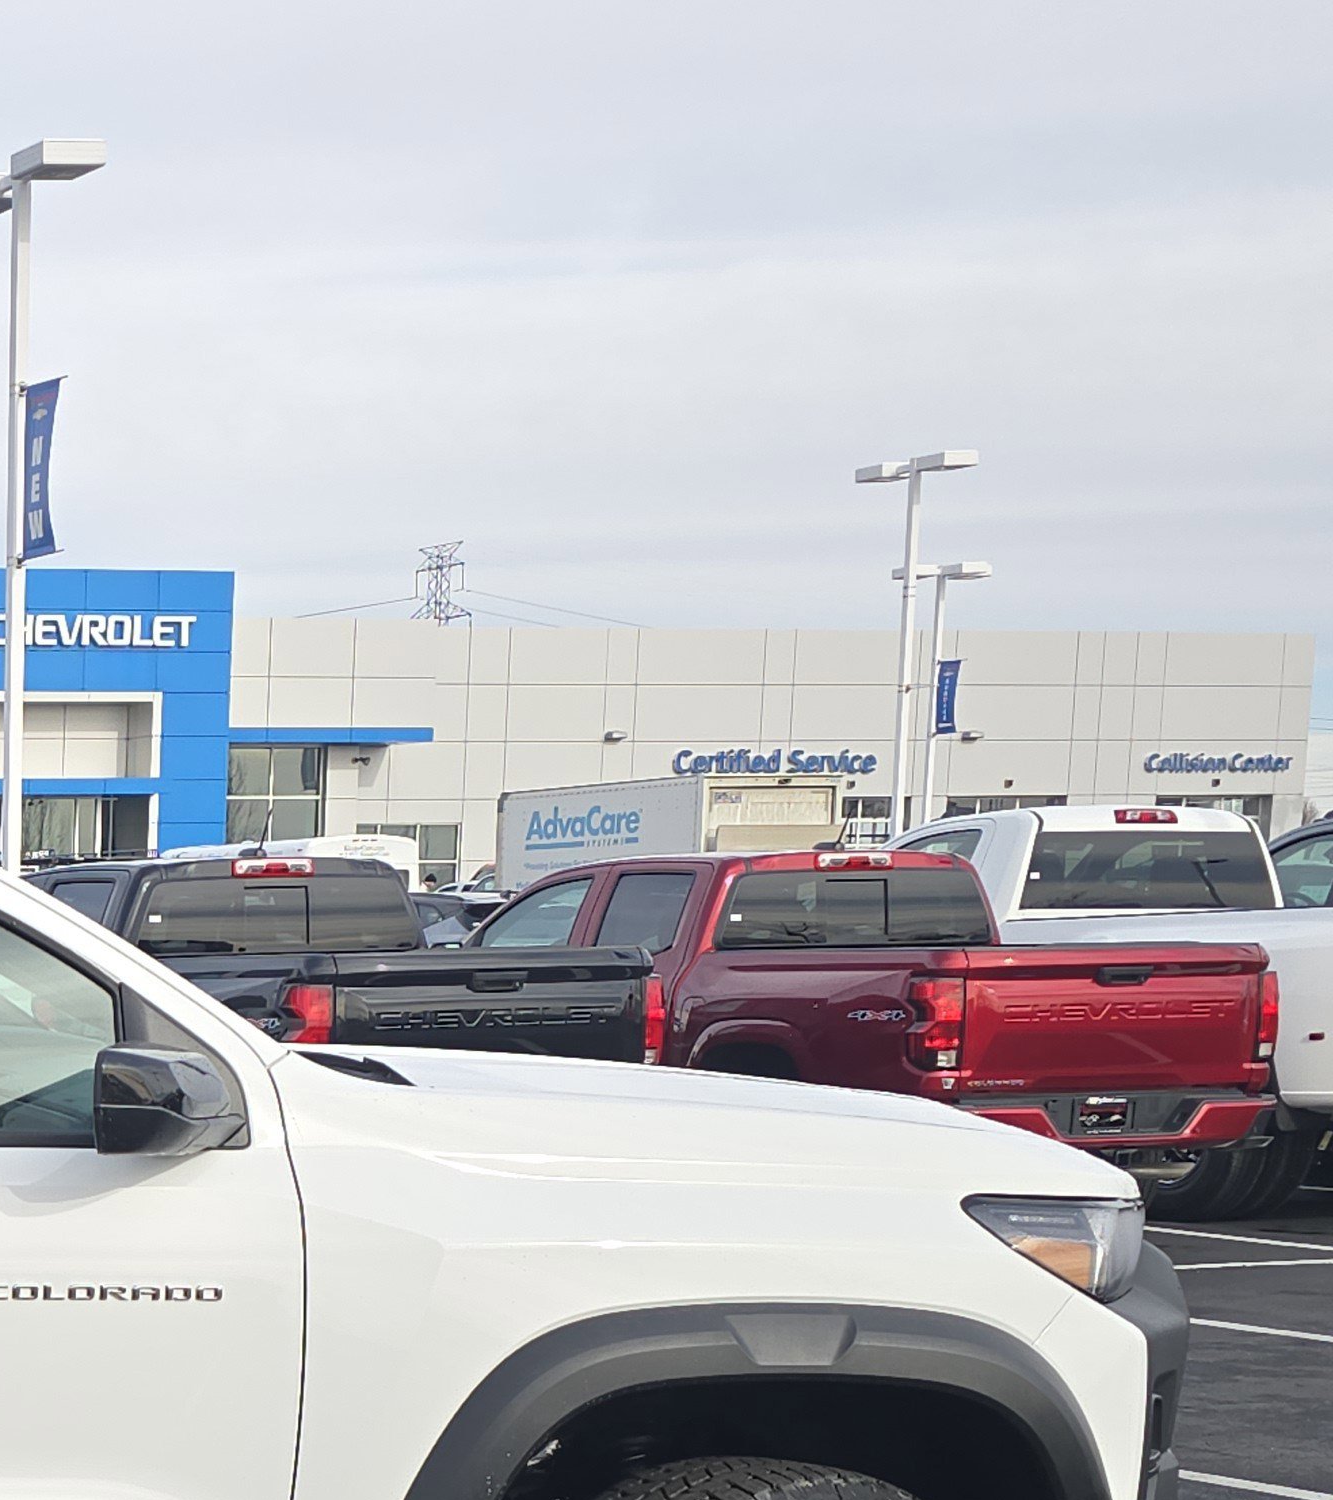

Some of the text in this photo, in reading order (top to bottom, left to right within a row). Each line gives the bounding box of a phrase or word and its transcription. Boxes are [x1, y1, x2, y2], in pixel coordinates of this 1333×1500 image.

[28, 435, 44, 541] NEW
[673, 749, 877, 774] Certified Service
[1144, 753, 1293, 773] Collision Center
[526, 805, 641, 841] AdvaCare
[375, 1005, 617, 1030] CHEVROLET
[1004, 1001, 1235, 1022] CHEVROLET
